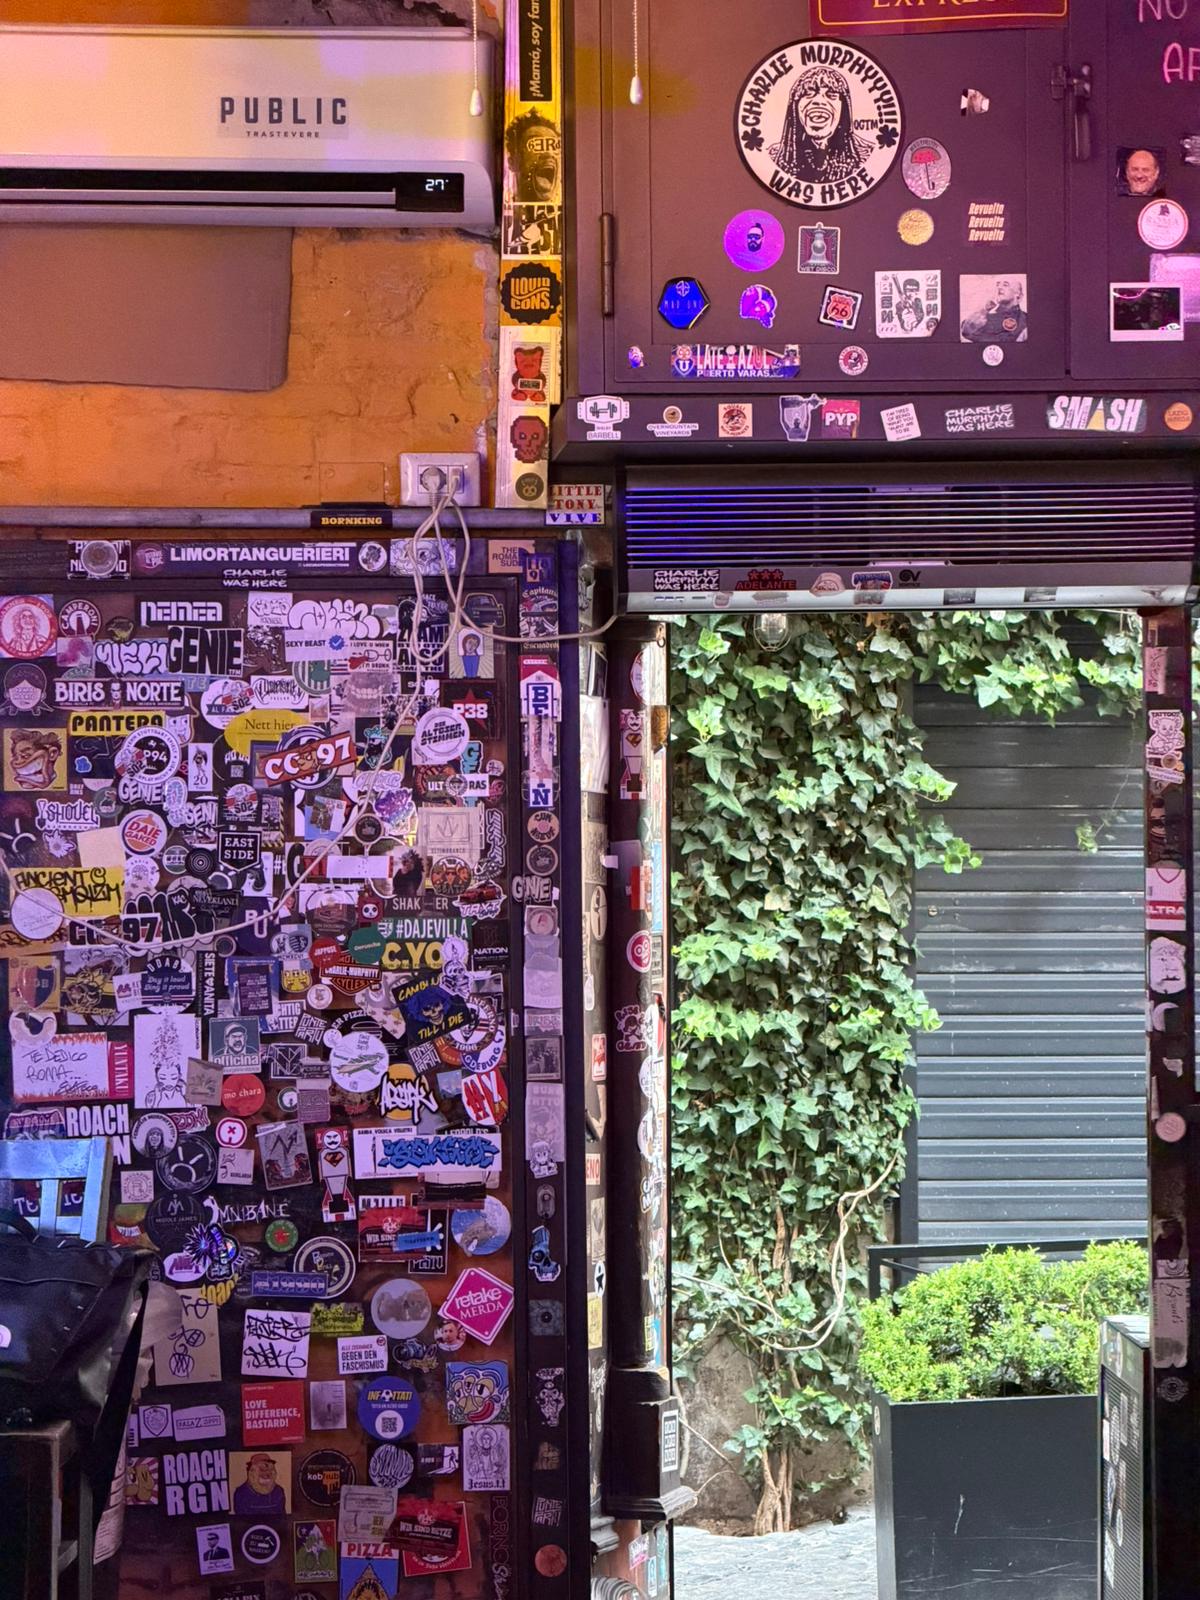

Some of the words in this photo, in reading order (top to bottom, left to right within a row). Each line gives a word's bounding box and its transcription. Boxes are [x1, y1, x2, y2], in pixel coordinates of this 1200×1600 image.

[531, 21, 544, 46] soy
[741, 53, 793, 127] CHARLIE
[800, 45, 898, 125] MURPHYYY!!!
[220, 97, 347, 125] PUBLIC
[246, 130, 321, 138] TRASTEVERE
[769, 169, 814, 204] WAS
[820, 168, 874, 204] HERE
[945, 404, 1013, 417] CHARLIE
[1048, 395, 1143, 433] SMASH
[825, 411, 857, 426] PYP
[946, 412, 1014, 425] MURPHYYY
[947, 421, 976, 433] WAS
[977, 418, 1014, 431] HERE
[555, 499, 596, 510] TONY
[321, 516, 382, 526] BORNKING
[549, 512, 603, 523] VIVE
[223, 569, 287, 577] CHARLIE
[654, 568, 719, 577] CHARLIE
[223, 579, 249, 587] WAS
[252, 579, 287, 587] HERE
[655, 576, 719, 584] MURPHYYY
[736, 580, 796, 590] ADELANTE
[654, 583, 683, 591] WAS
[686, 582, 719, 591] HERE
[286, 640, 303, 648] SEXY
[304, 639, 326, 648] BEAST
[55, 682, 105, 702] BIRIS
[126, 682, 182, 702] NORTE
[72, 715, 163, 732] PANTERA
[244, 718, 271, 731] Nett
[193, 774, 208, 786] 20
[224, 838, 255, 848] EAST
[224, 850, 254, 860] SIDE
[396, 918, 469, 939] #DAJEVILLA
[473, 947, 508, 955] NATION
[333, 978, 367, 990] CYCLES
[418, 1025, 441, 1039] TILL
[447, 1011, 465, 1026] DIE
[66, 1103, 129, 1137] ROACH
[455, 1287, 502, 1309] retake
[460, 1301, 504, 1320] MERDA
[341, 1351, 363, 1361] GEGEN
[364, 1350, 378, 1359] DEN
[342, 1360, 385, 1371] FASCHISMUS
[244, 1400, 267, 1410] LOVE
[245, 1408, 301, 1420] DIFFERENCE,
[246, 1419, 289, 1430] BASTARD!
[163, 1449, 228, 1485] ROACH
[166, 1481, 230, 1516] RGN
[347, 1542, 393, 1557] PIZZA
